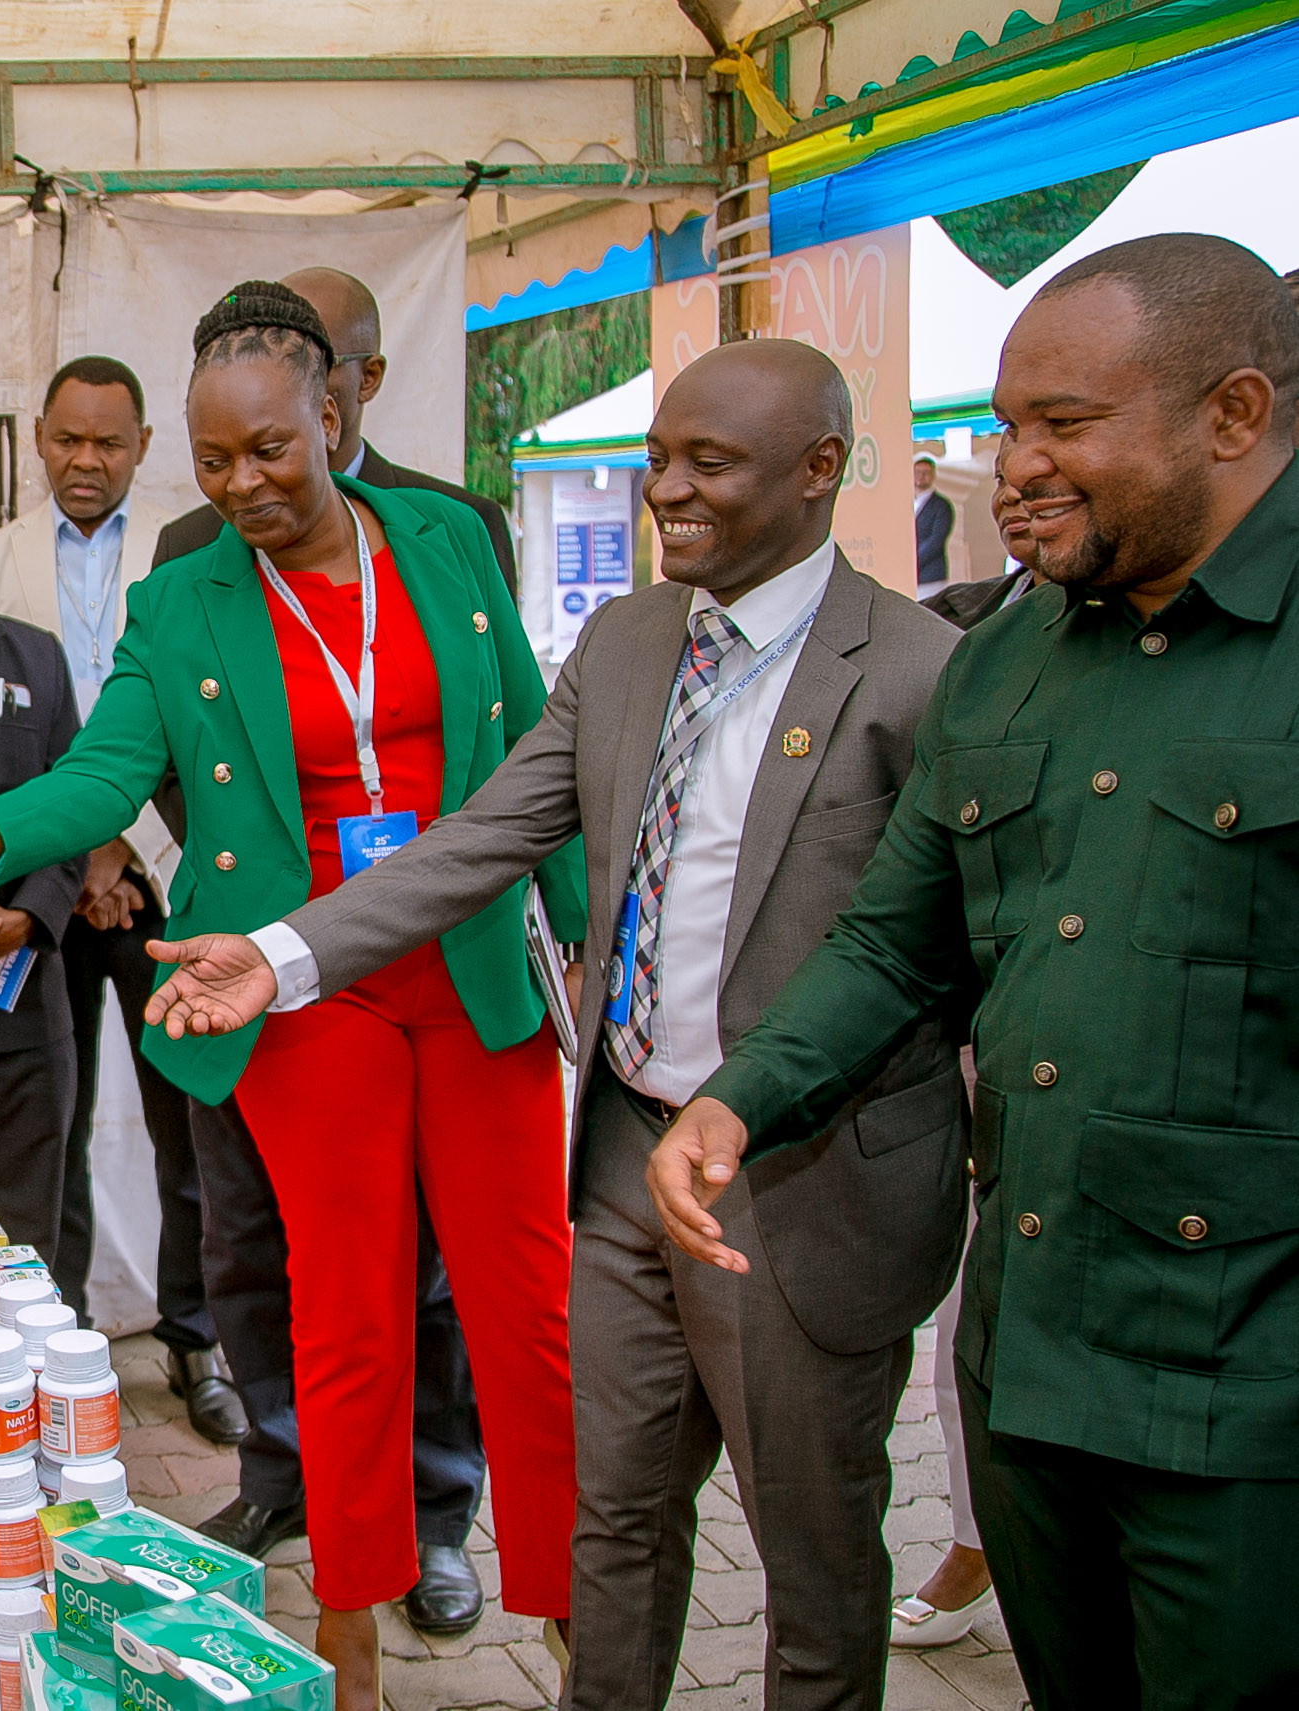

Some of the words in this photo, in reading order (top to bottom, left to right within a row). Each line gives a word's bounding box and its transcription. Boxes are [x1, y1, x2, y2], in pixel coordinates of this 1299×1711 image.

[723, 687, 740, 703] PAT
[737, 652, 779, 690] SCIENTIFIC
[5, 1416, 27, 1430] NAT
[27, 1407, 35, 1422] D
[129, 1542, 208, 1582] GOFEN
[188, 1556, 223, 1575] 200
[64, 1604, 88, 1629] 200
[191, 1633, 269, 1685] GOFEN
[251, 1653, 287, 1675] 200
